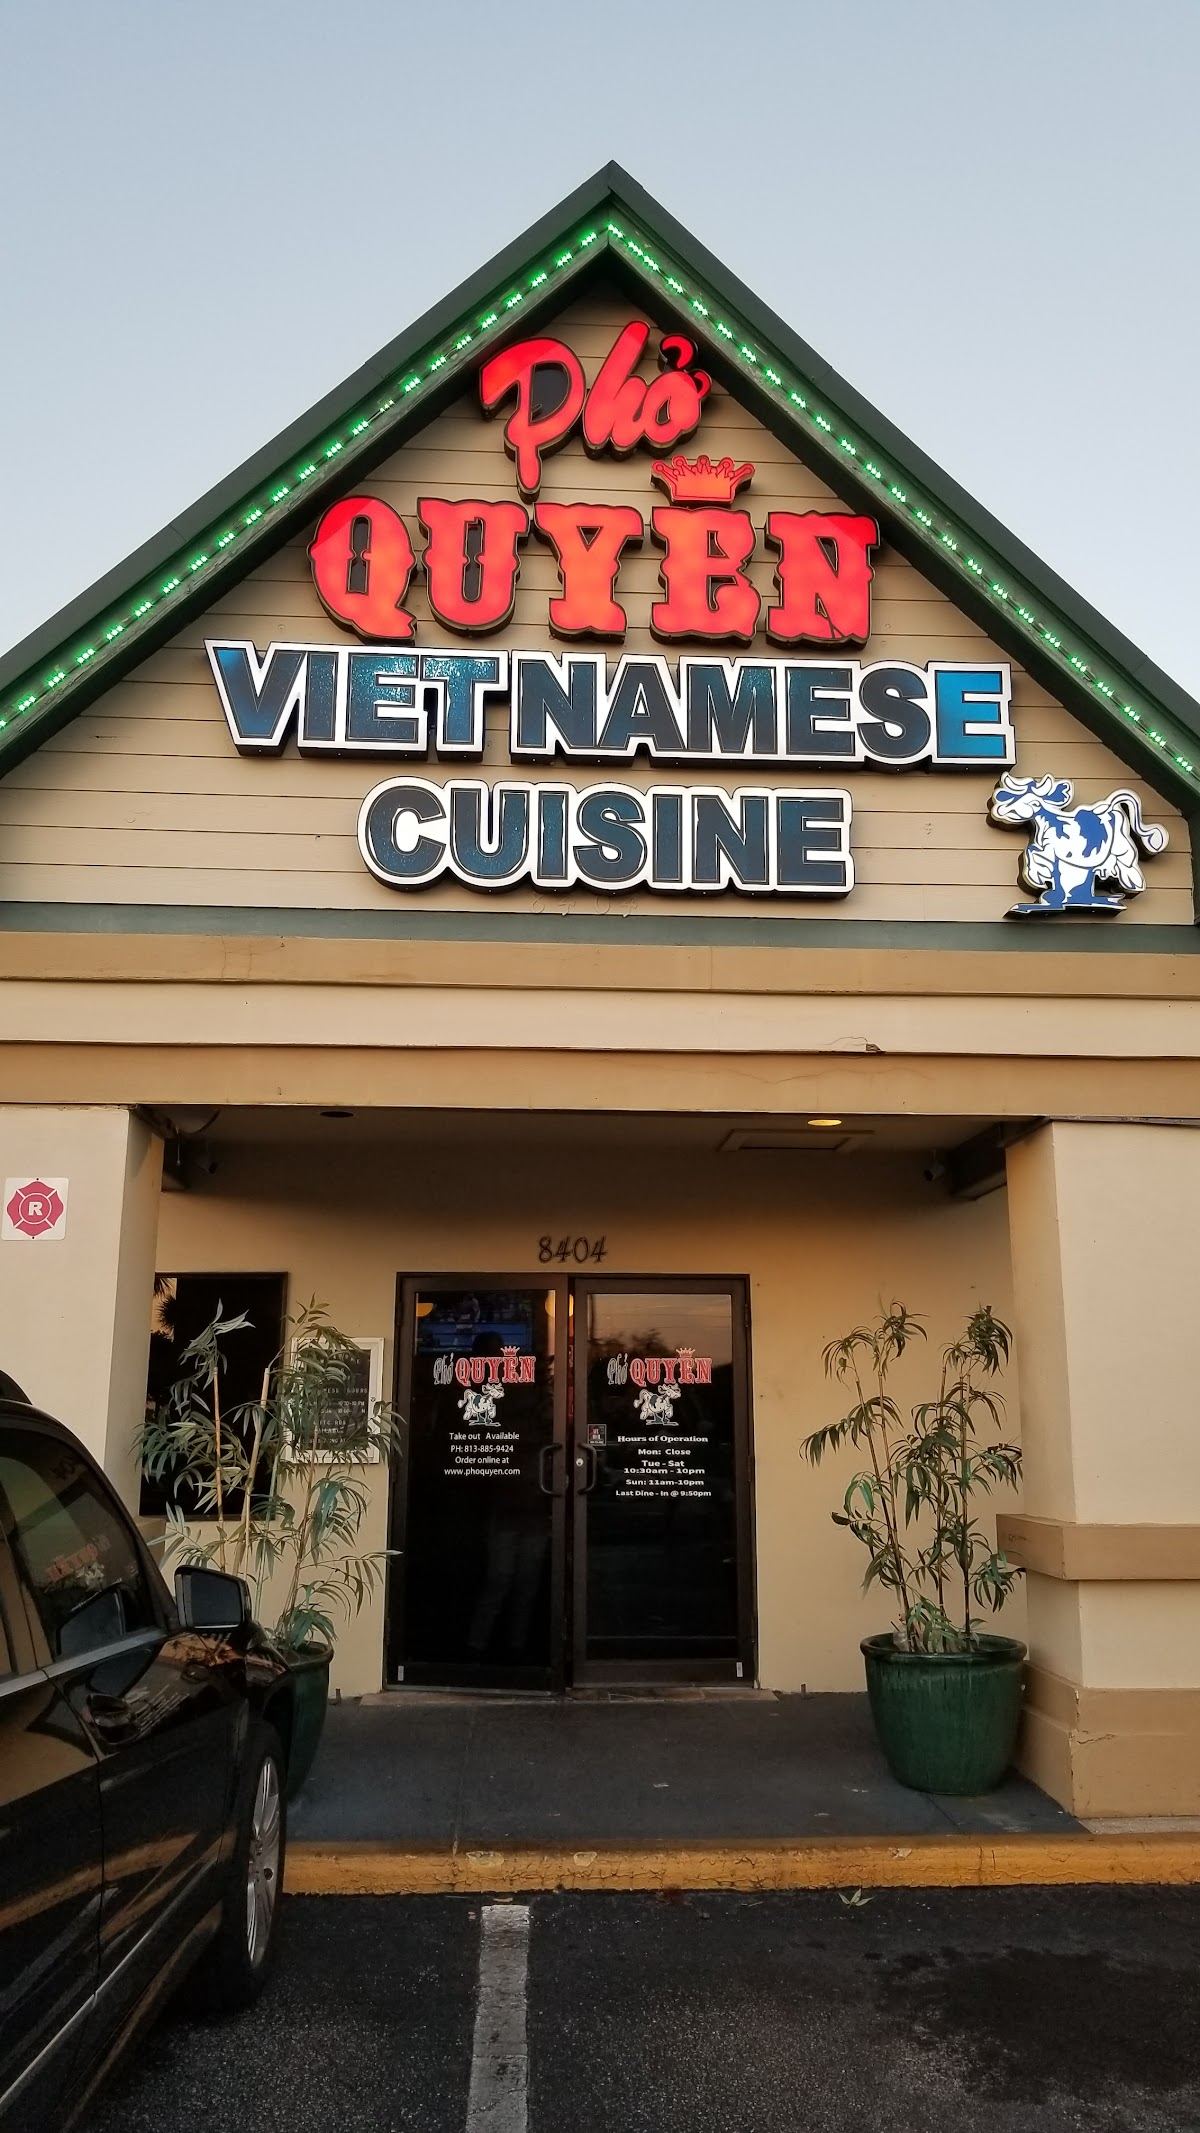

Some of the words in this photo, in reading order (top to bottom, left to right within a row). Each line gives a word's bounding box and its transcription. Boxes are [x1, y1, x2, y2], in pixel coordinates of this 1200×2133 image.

[204, 638, 1016, 768] VIETNAMESE
[356, 776, 855, 894] CUISINE
[28, 1201, 43, 1216] R
[538, 1235, 608, 1263] 8404
[449, 1432, 467, 1440] Take
[485, 1431, 520, 1440] Available
[617, 1435, 647, 1443] Hours
[660, 1435, 709, 1443] Operation
[450, 1445, 463, 1453] PH:
[464, 1445, 514, 1453] 813-885-9424
[638, 1448, 662, 1456] Mon:
[665, 1448, 691, 1456] Close
[455, 1456, 476, 1464] Order
[477, 1456, 501, 1464] online
[501, 1456, 510, 1464] at
[641, 1459, 661, 1467] Tue
[668, 1459, 685, 1467] Sat
[444, 1467, 521, 1477] www.phoquyen.com
[676, 1467, 706, 1475] 10pm
[648, 1479, 705, 1487] 11am-10pm
[615, 1489, 634, 1497] Last
[635, 1489, 655, 1497] Dine
[670, 1490, 679, 1498] @
[680, 1490, 712, 1498] 9:50pm
